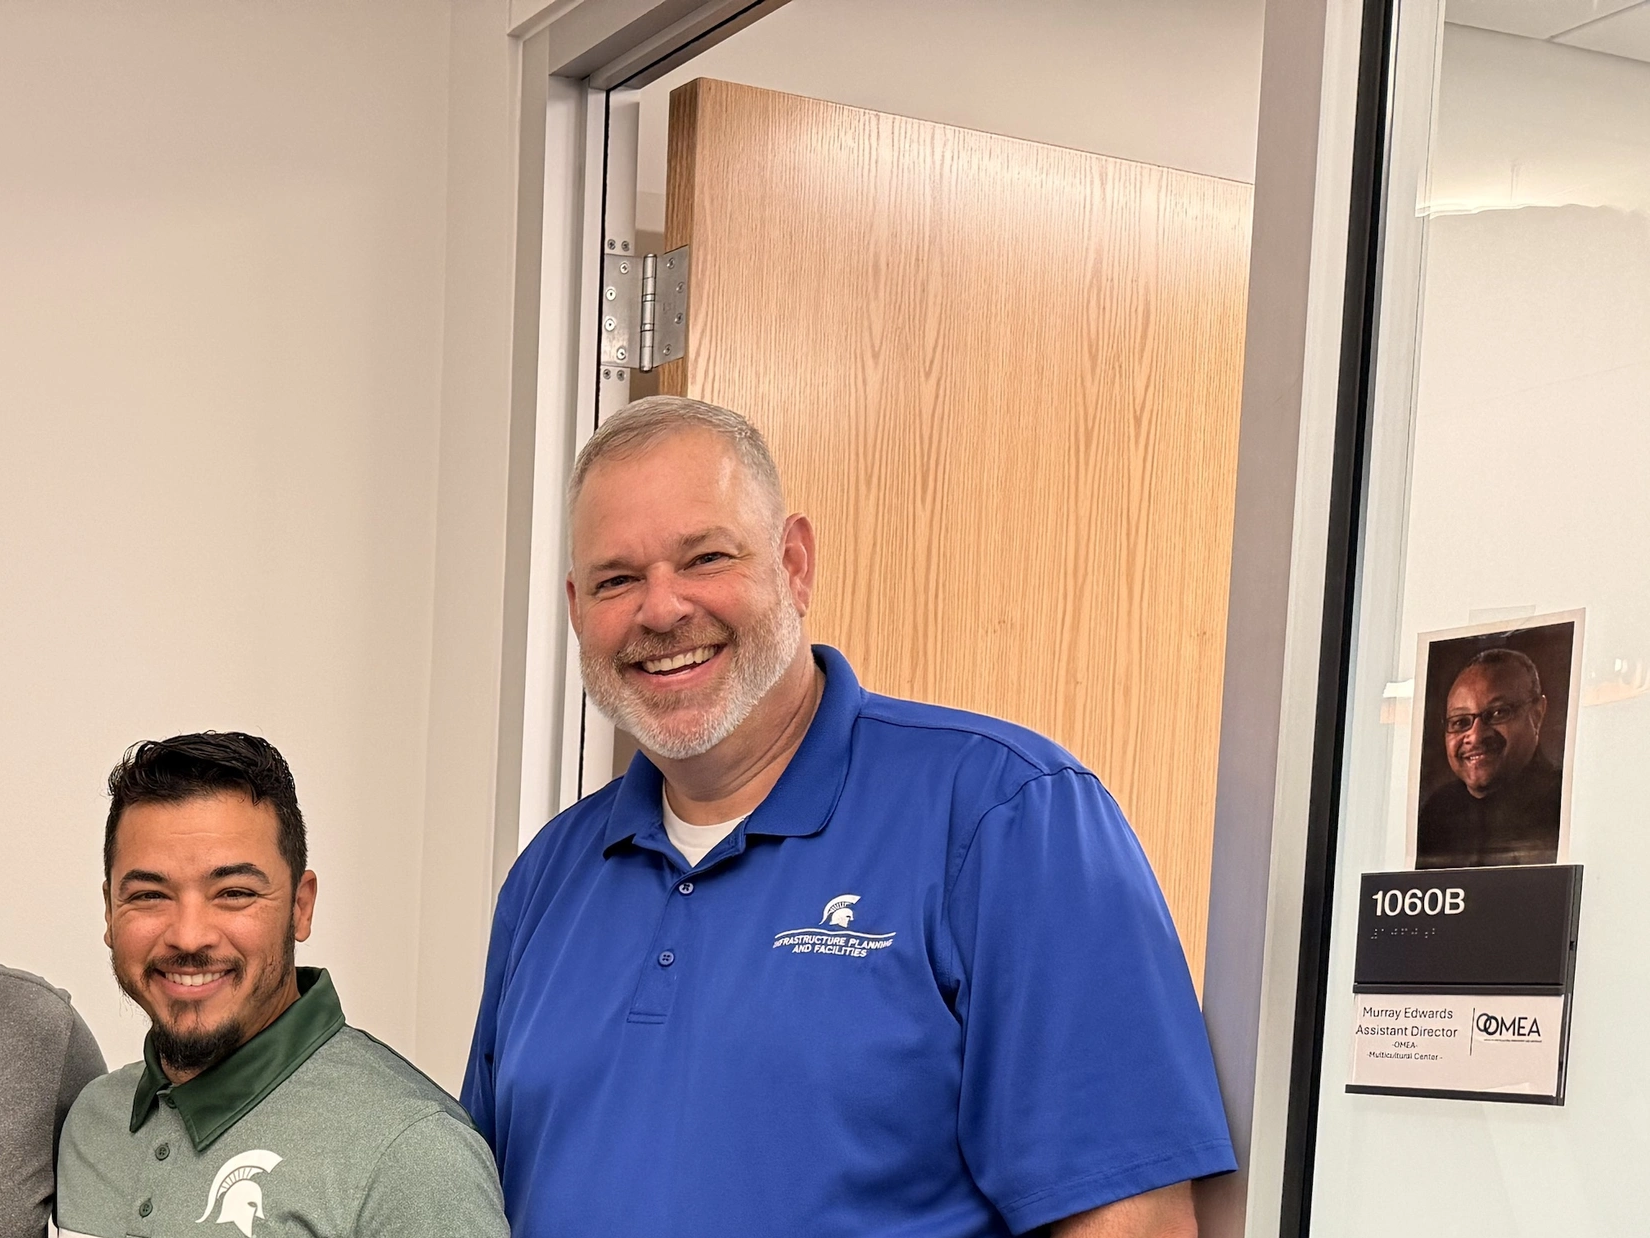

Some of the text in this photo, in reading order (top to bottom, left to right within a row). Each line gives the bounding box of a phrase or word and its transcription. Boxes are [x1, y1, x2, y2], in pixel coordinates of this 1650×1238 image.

[1371, 887, 1466, 917] 1060B
[772, 935, 894, 950] INFRASTRUCTURE PLANNING
[792, 944, 868, 957] AND FACILITIES
[1362, 1006, 1454, 1021] Murray Edwards
[1355, 1024, 1458, 1038] Assistant Director
[1413, 1052, 1439, 1061] Center
